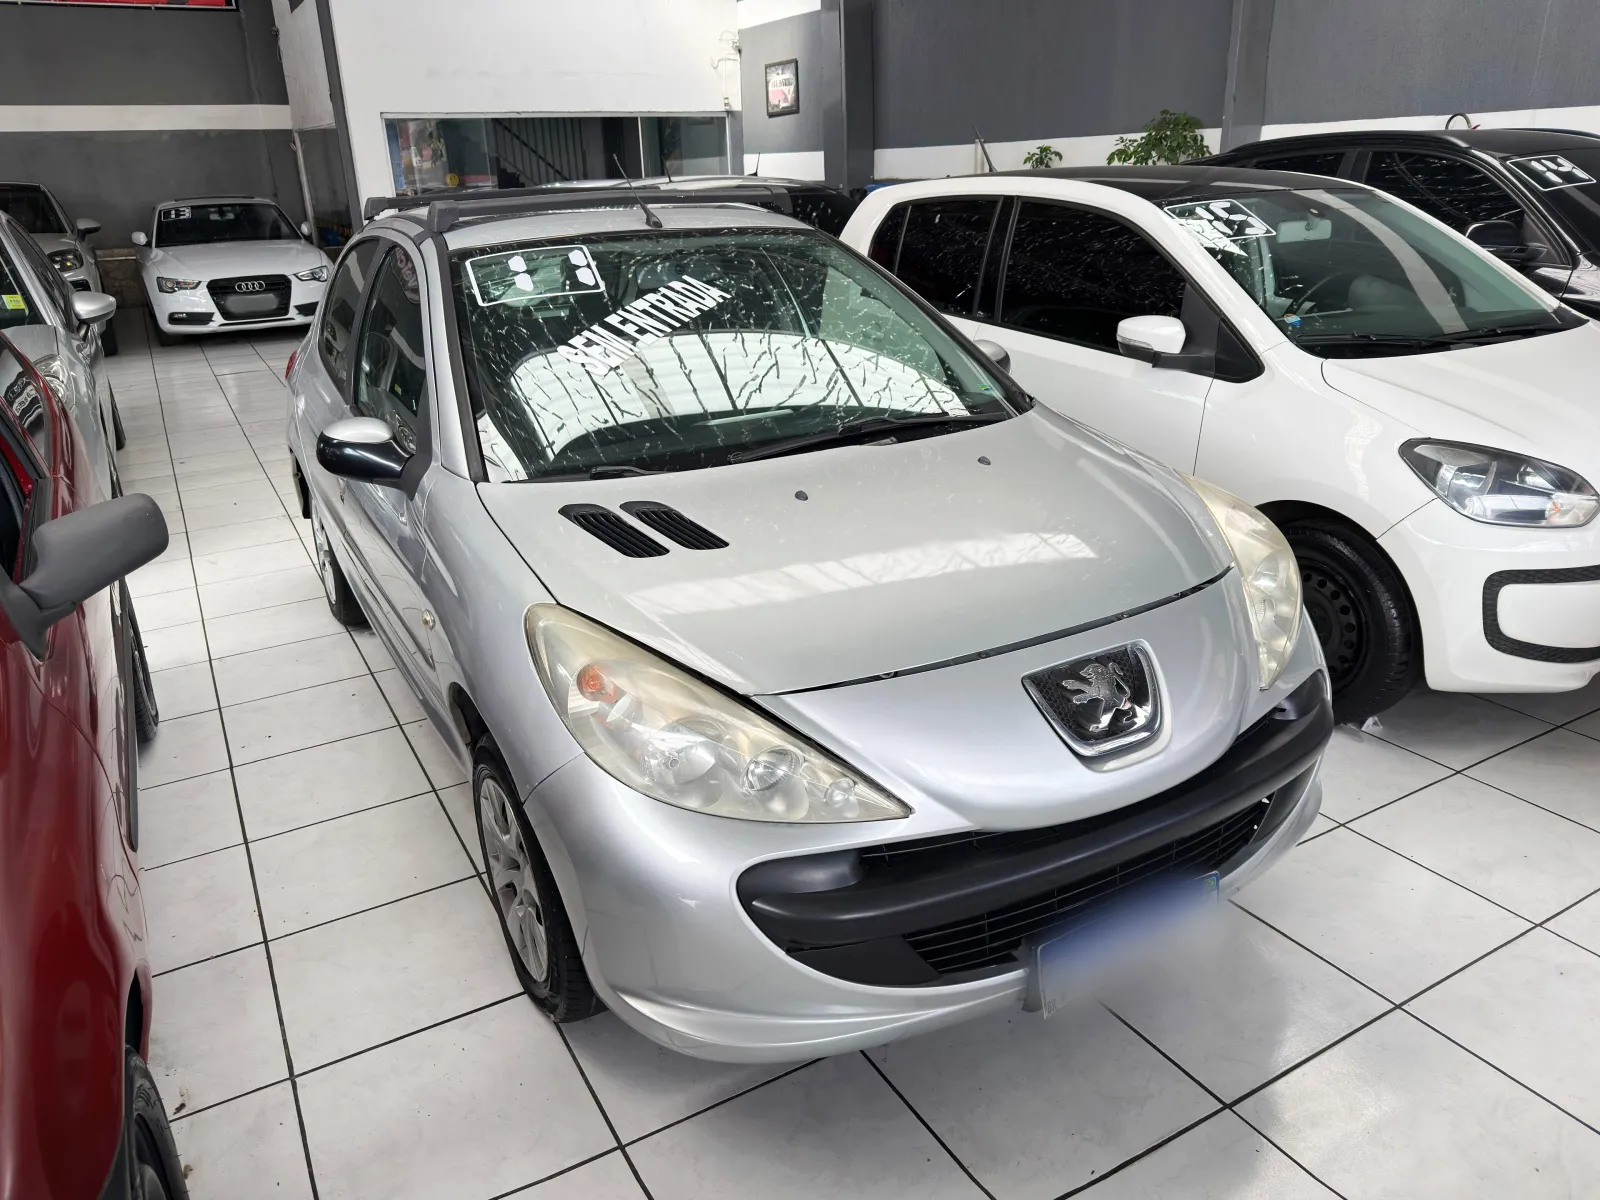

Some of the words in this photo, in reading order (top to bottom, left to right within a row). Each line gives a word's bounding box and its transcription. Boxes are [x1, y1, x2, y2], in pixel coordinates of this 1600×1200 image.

[1531, 157, 1589, 183] 14
[170, 208, 190, 219] 13
[1195, 201, 1267, 235] 15
[508, 249, 596, 291] 11
[557, 325, 640, 377] SEM
[604, 275, 733, 346] ENTRADA
